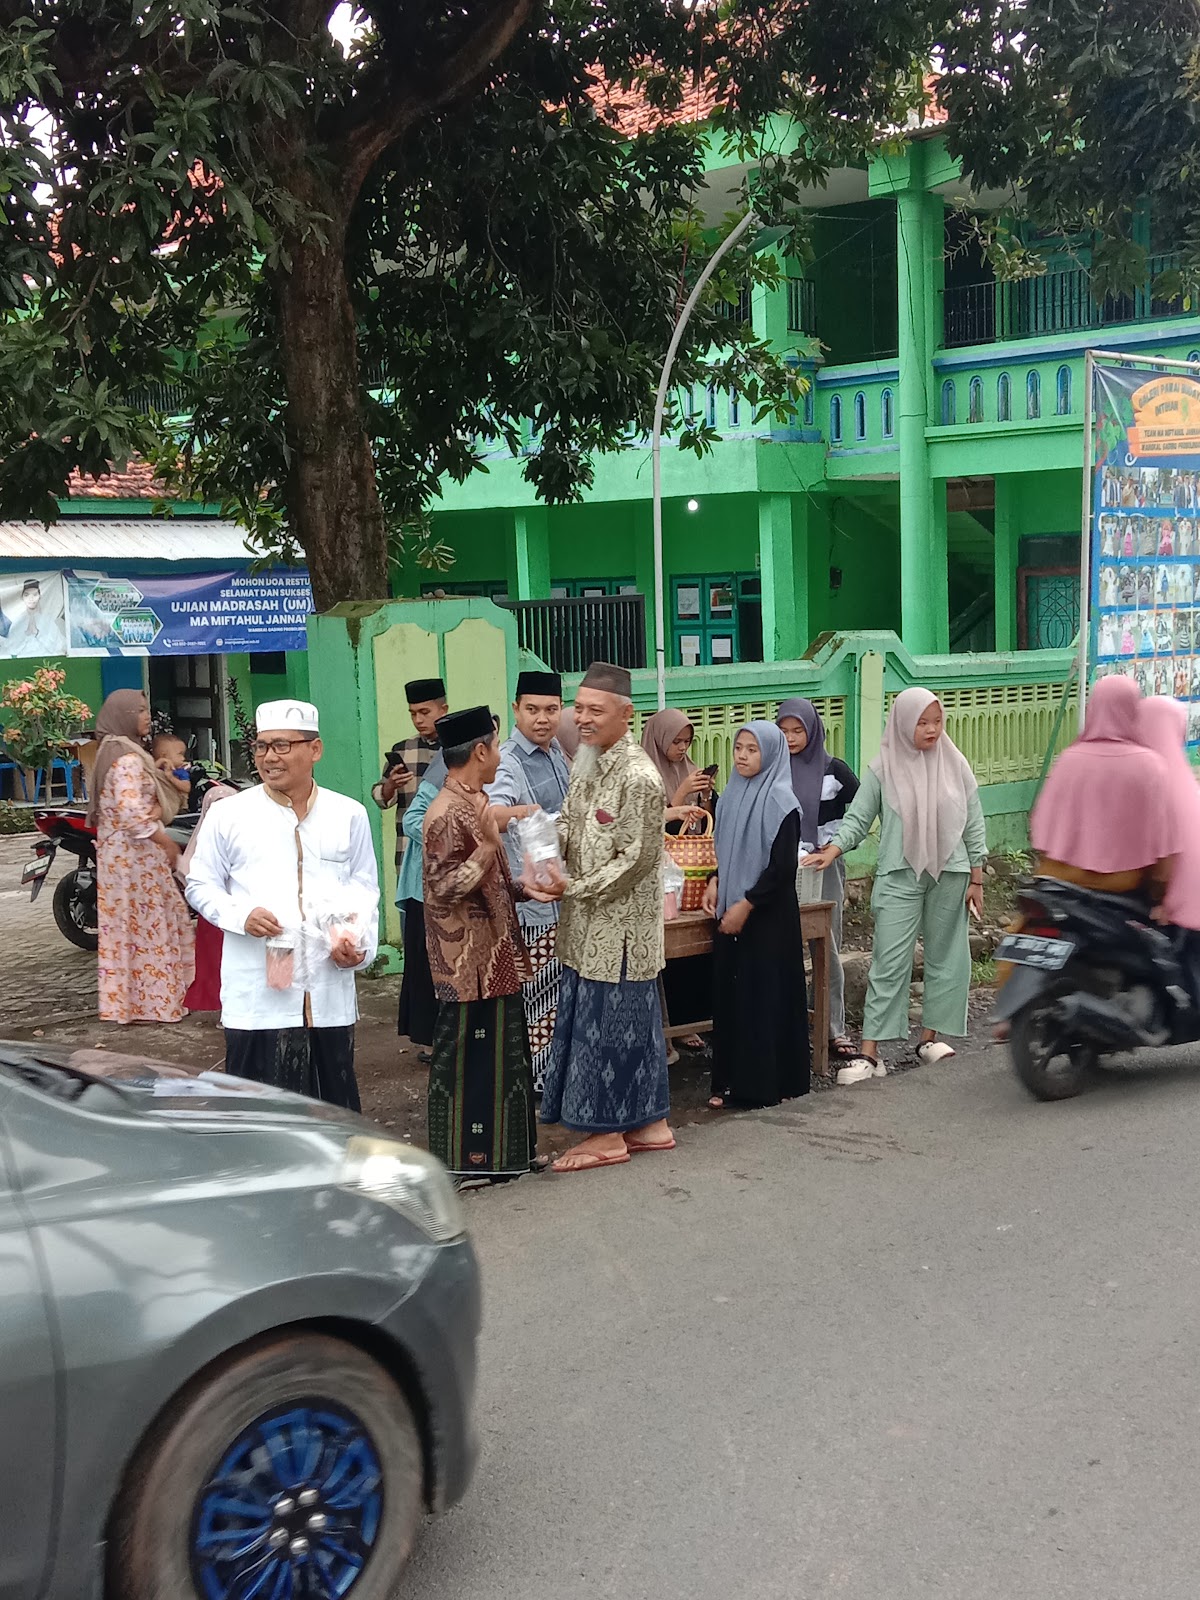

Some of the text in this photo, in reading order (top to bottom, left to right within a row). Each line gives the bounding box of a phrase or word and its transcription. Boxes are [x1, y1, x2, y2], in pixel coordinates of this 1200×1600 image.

[231, 577, 311, 587] MOHON DOA RESTU
[220, 588, 311, 598] SELAMAT DAN SUKSES
[171, 597, 312, 613] UJIAN MADRASAH (UM)
[190, 616, 209, 627] MA
[211, 615, 265, 626] MIFTAHUL
